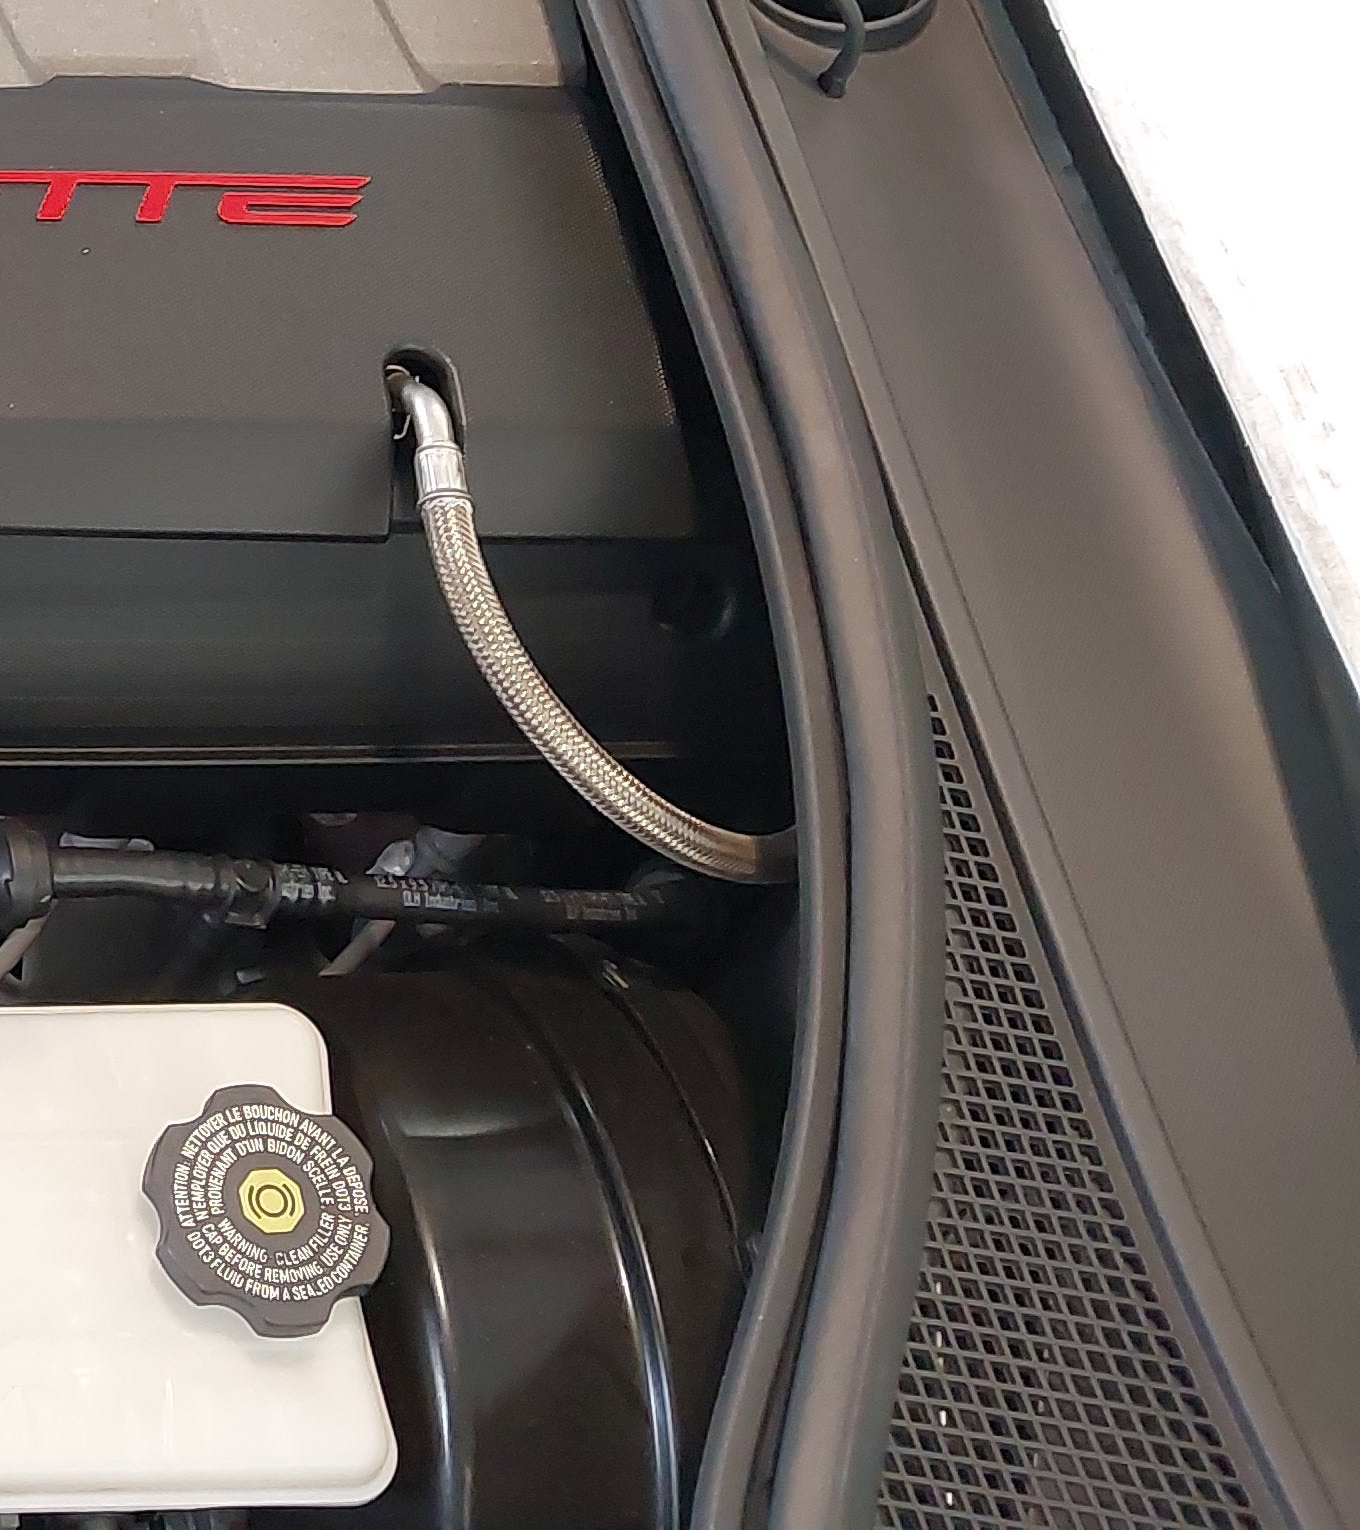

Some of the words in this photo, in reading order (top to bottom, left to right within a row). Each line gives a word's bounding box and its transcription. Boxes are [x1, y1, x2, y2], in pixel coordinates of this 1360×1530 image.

[180, 1112, 229, 1160] NETTOYER
[225, 1106, 243, 1124] LE
[242, 1104, 300, 1128] BOUCHON
[299, 1118, 337, 1151] AVANT
[331, 1147, 351, 1168] LA
[206, 1129, 232, 1154] QUE
[227, 1122, 247, 1140] DU
[247, 1120, 295, 1142] LIQUIDE
[293, 1132, 312, 1151] DE
[309, 1145, 341, 1180] FREIN
[207, 1147, 239, 1215] PROVENANT
[267, 1138, 305, 1165] BIDON
[201, 1223, 224, 1245] CAP
[217, 1242, 263, 1279] BEFORE
[319, 1242, 344, 1267] USE
[334, 1214, 353, 1246] ONLY
[274, 1244, 315, 1266] CLEAN
[308, 1212, 336, 1253] FILLER
[209, 1257, 245, 1288] FLUID
[244, 1278, 280, 1301] FROM
[282, 1286, 291, 1301] A
